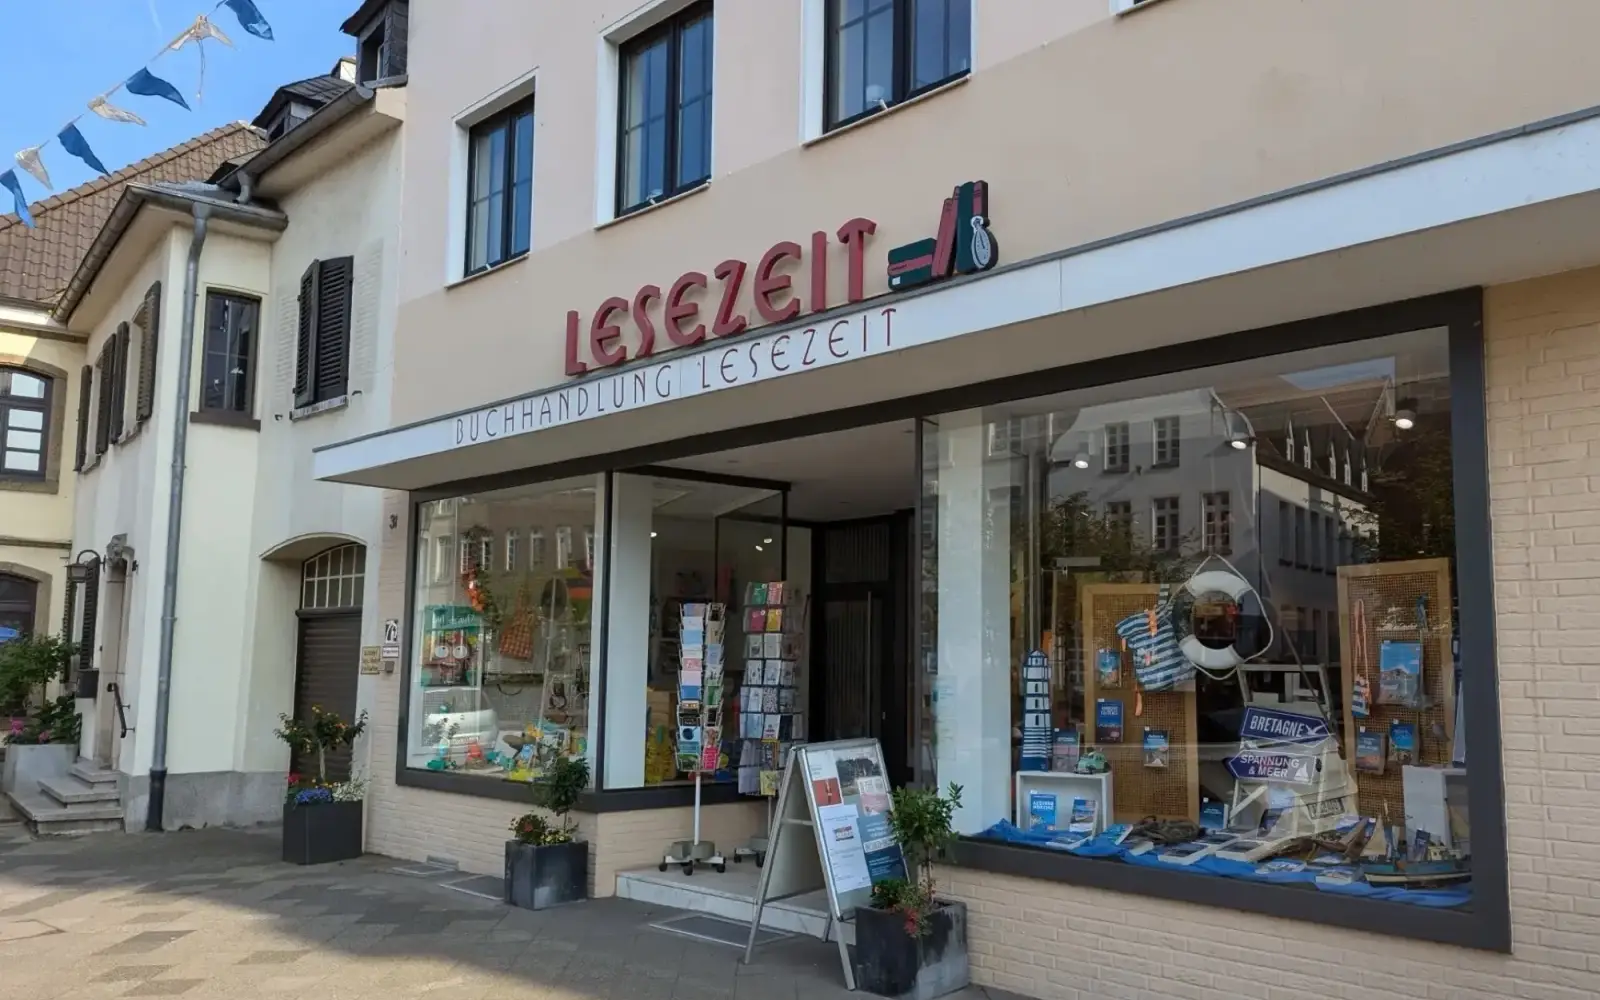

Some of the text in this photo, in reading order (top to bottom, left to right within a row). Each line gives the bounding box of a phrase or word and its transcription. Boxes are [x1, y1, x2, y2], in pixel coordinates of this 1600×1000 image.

[564, 217, 877, 377] LESEZEIT
[455, 307, 898, 445] BUCHHANDLUNG LESEZEIT
[1250, 715, 1305, 738] BRETAGNE
[1240, 754, 1300, 769] SPANNUNG
[1248, 765, 1288, 778] & MEER
